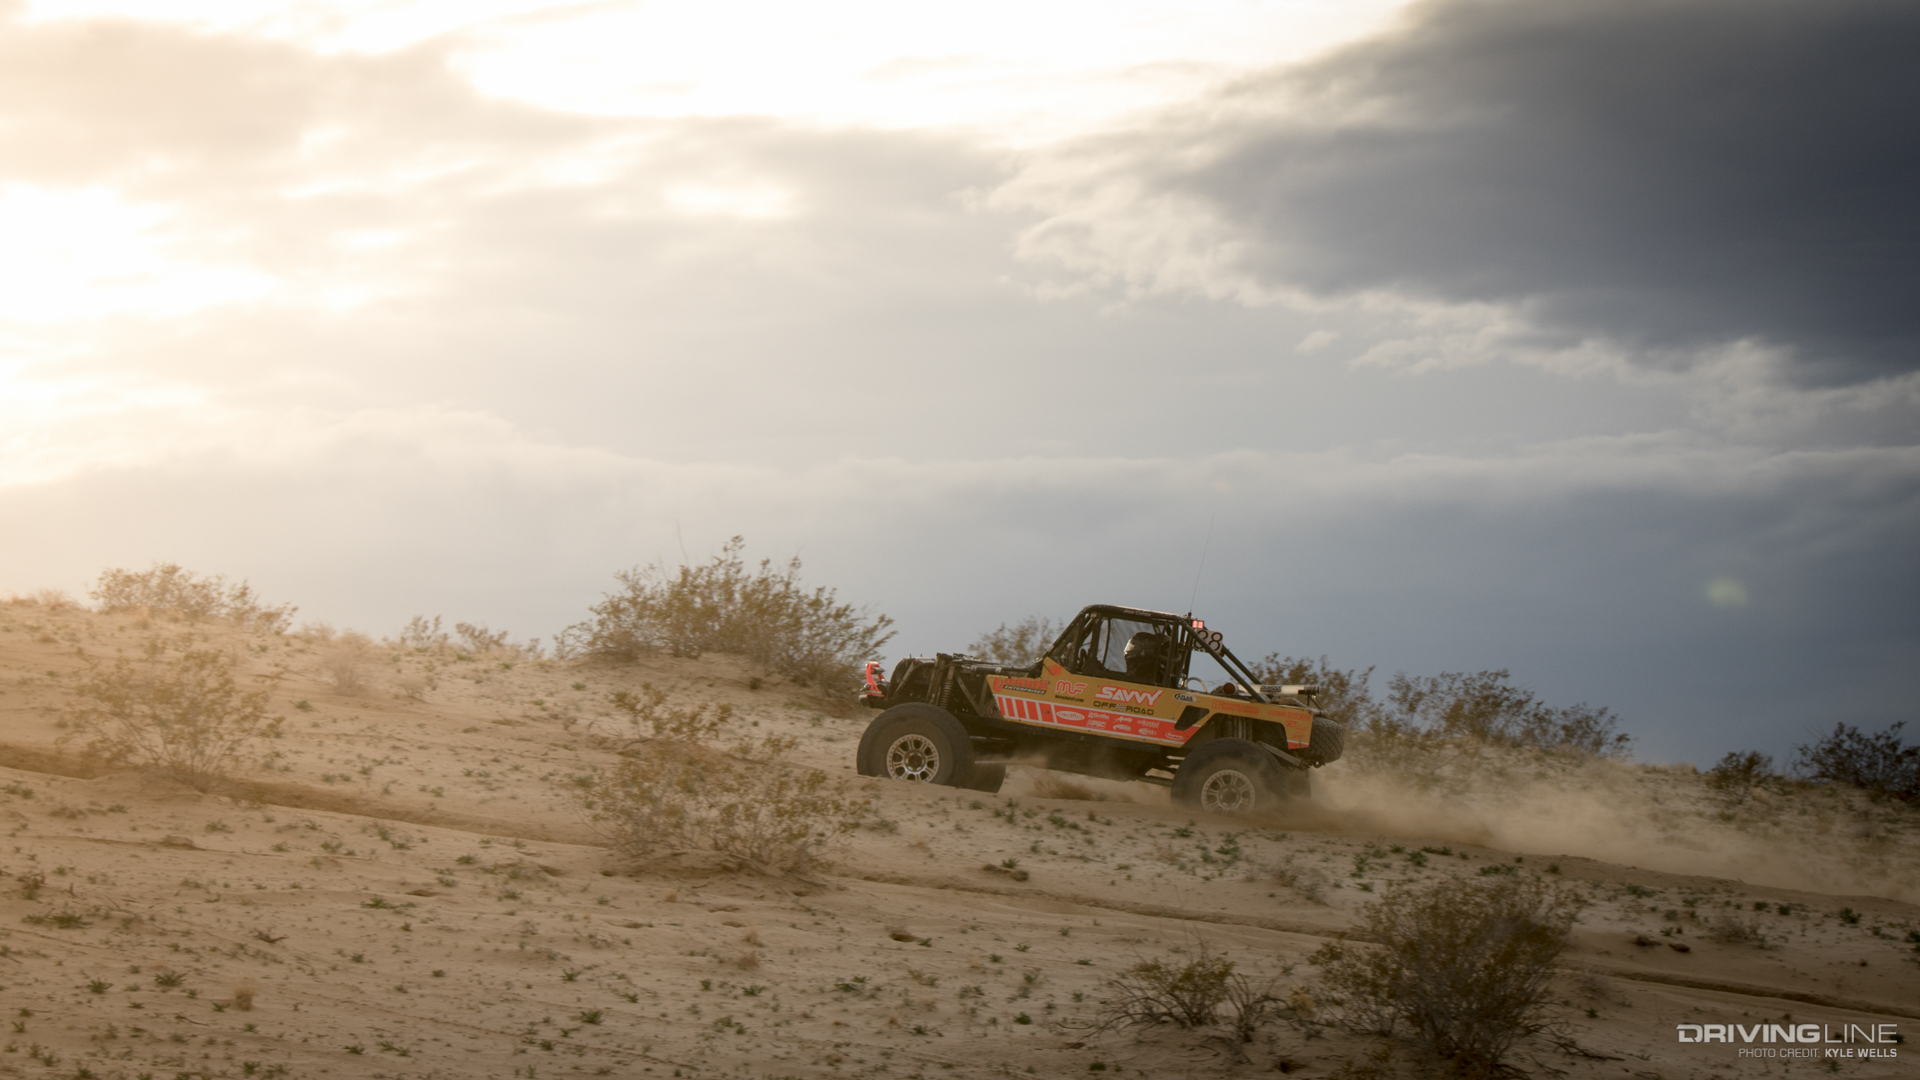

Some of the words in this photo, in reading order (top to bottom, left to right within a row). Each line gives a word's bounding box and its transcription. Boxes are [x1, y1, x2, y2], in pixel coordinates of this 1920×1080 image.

[1003, 685, 1047, 695] ENTERPRISES
[1094, 685, 1164, 707] SAVVY
[1093, 700, 1117, 709] OFF
[1125, 705, 1155, 715] ROAD
